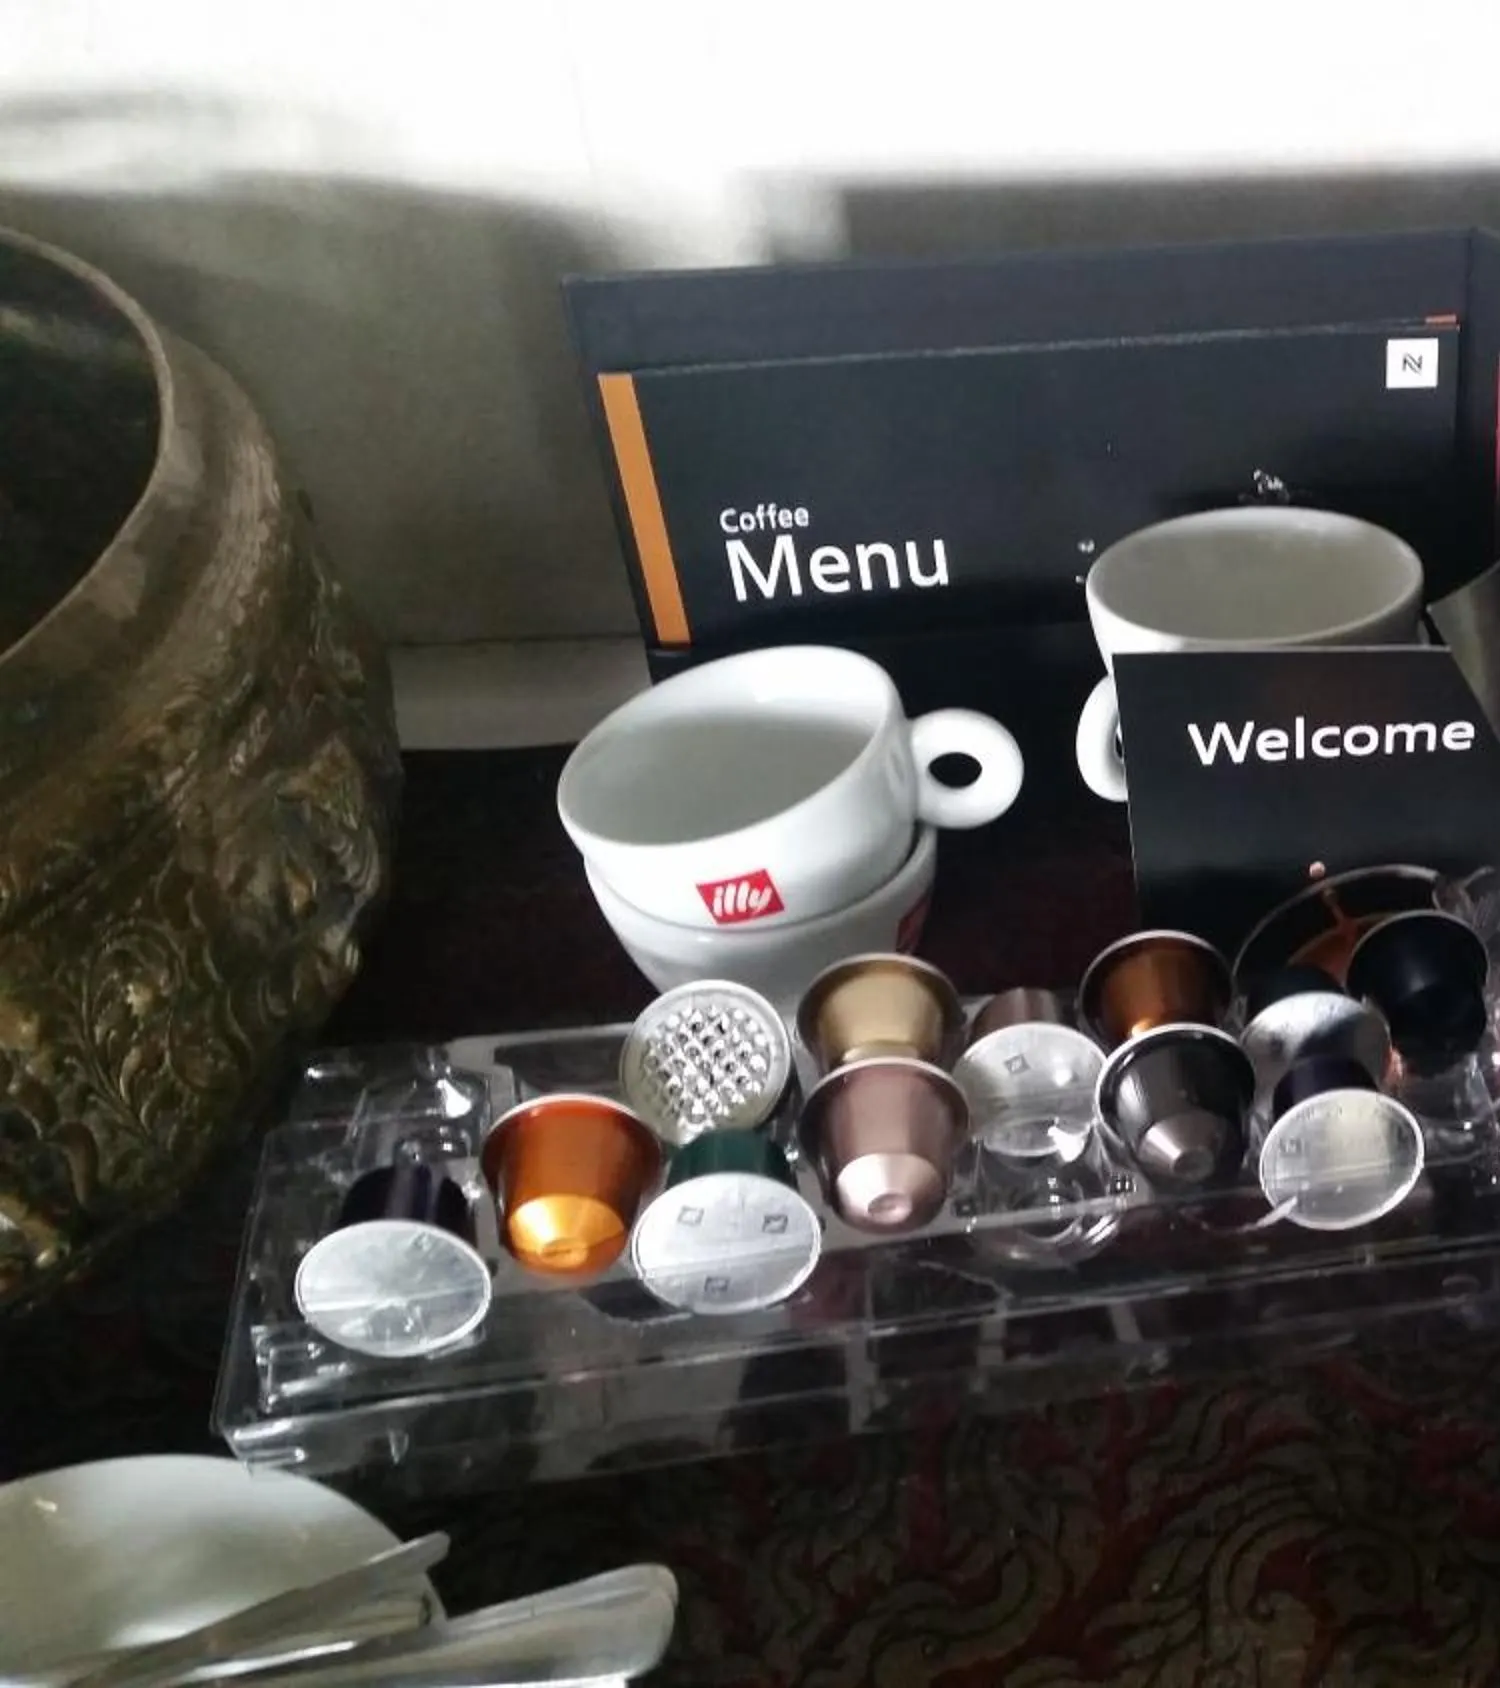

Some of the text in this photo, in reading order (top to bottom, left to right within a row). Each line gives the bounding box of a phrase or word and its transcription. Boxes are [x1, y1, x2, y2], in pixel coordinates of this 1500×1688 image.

[719, 503, 810, 534] Coffee
[725, 534, 950, 603] Menu
[1187, 716, 1476, 766] Welcome
[712, 879, 773, 918] illy
